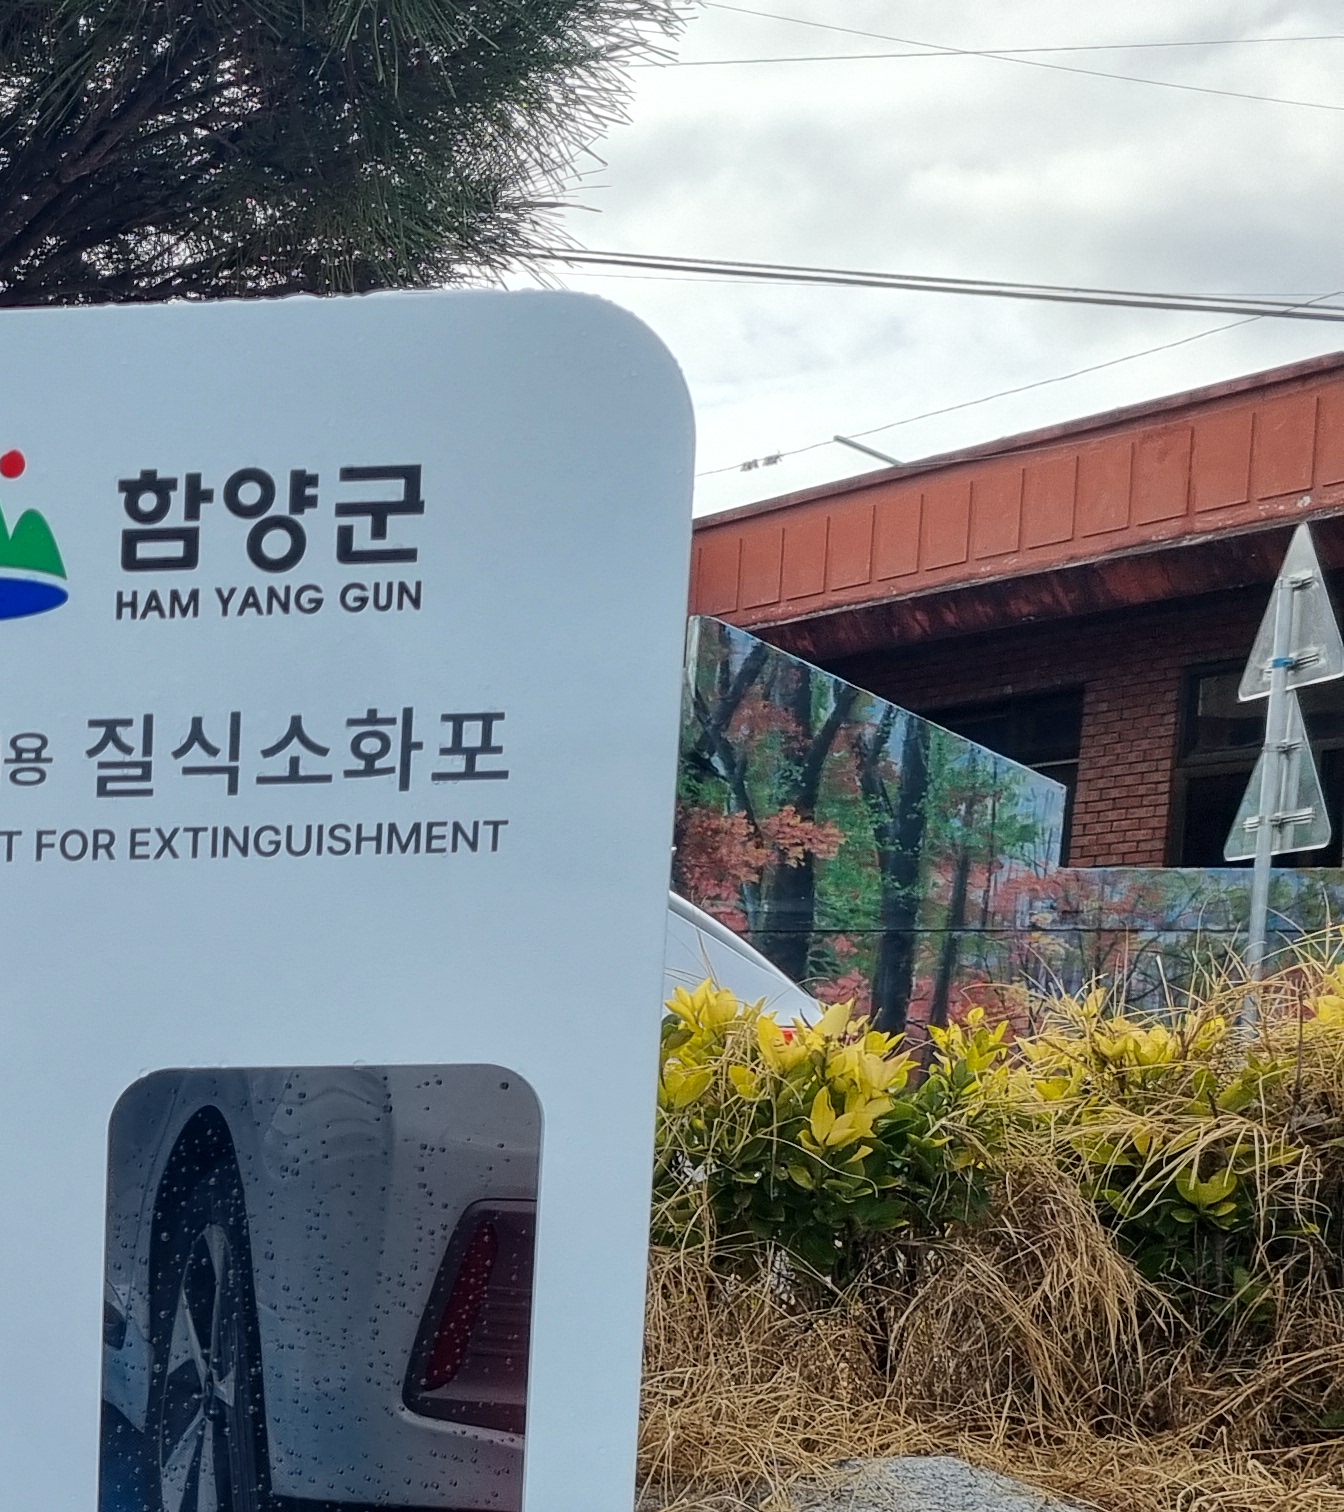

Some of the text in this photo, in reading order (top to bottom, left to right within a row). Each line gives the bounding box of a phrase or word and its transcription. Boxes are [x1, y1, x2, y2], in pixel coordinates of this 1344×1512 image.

[118, 463, 425, 573] 함양군
[115, 579, 423, 620] HAM YANG GUN
[85, 706, 510, 798] 질식소화포
[35, 827, 117, 863] FOR
[128, 819, 510, 861] EXTINGUISHMENT
